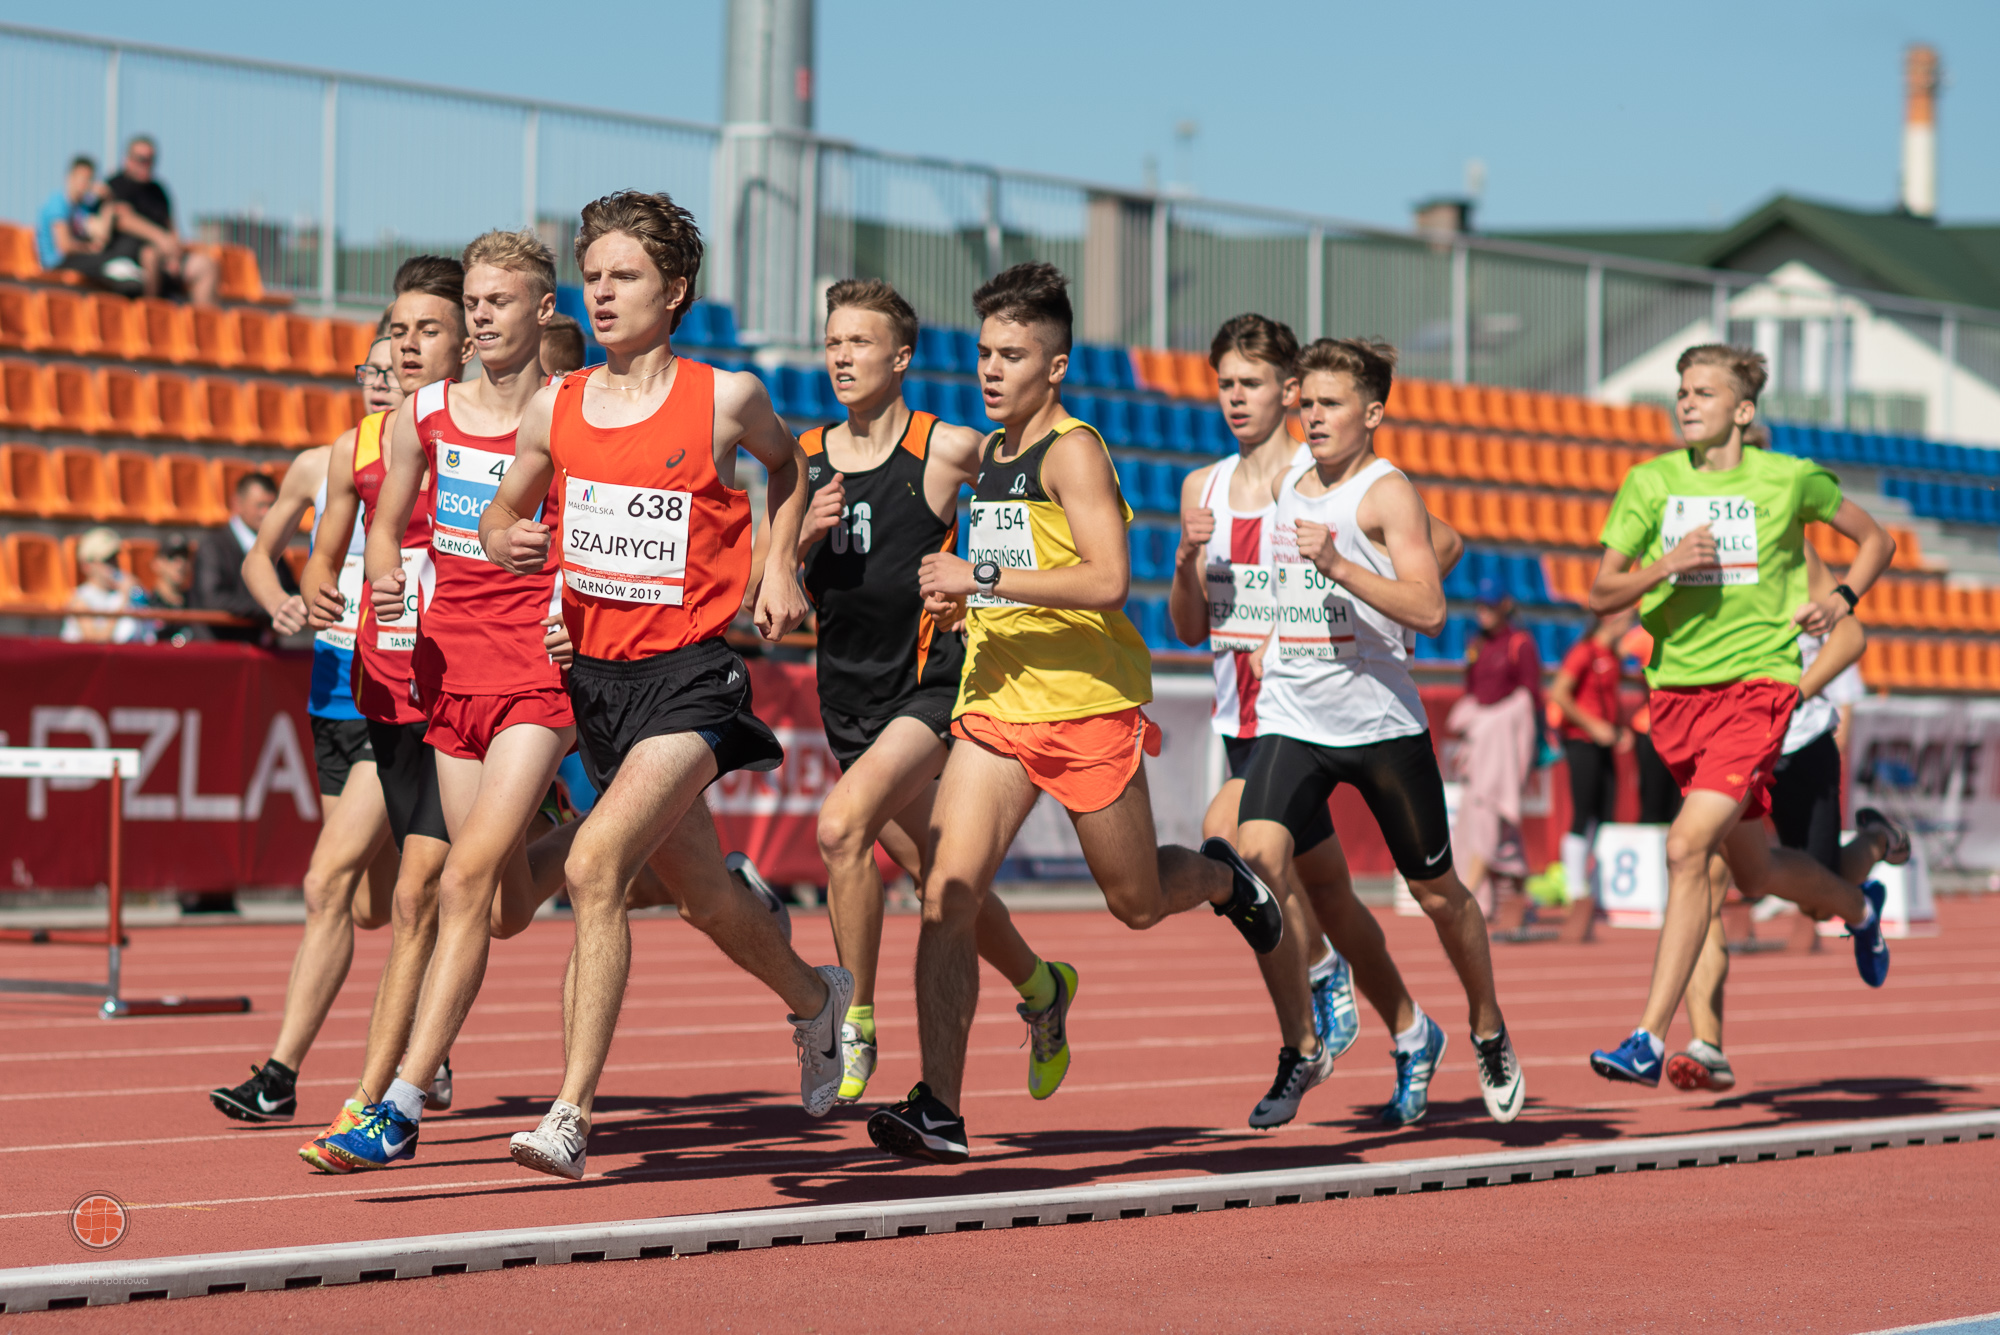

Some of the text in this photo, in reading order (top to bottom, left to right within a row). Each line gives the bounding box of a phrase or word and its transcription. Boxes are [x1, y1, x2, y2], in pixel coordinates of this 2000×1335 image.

[568, 501, 614, 516] MAŁOPOLSKA
[627, 493, 683, 521] 638
[1709, 499, 1749, 520] 516
[831, 501, 872, 554] 66
[995, 507, 1024, 530] 154
[438, 537, 483, 556] TARNÓW
[571, 529, 675, 561] SZAJRYCH
[1244, 570, 1269, 589] 29
[1677, 572, 1741, 583] ARNÓW 2019
[577, 578, 661, 600] TARNÓW 2019
[1214, 640, 1250, 651] TARNÓW
[1280, 644, 1339, 657] TARNÓW 2019
[28, 706, 319, 820] PZLA
[1611, 849, 1638, 897] 8
